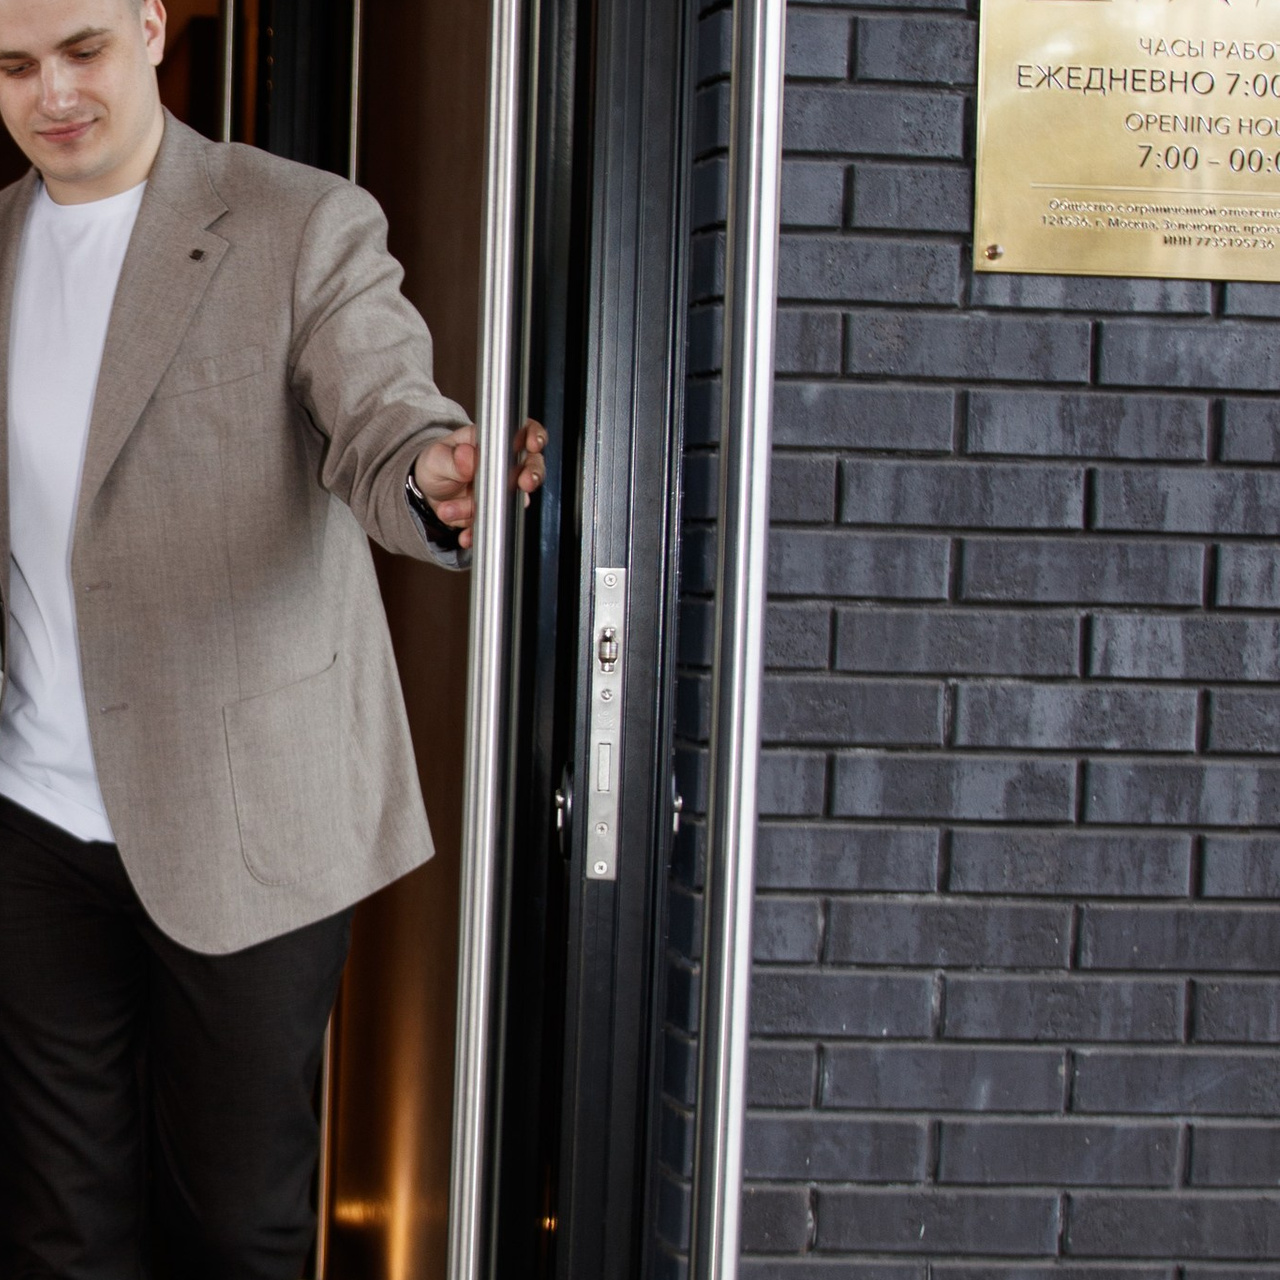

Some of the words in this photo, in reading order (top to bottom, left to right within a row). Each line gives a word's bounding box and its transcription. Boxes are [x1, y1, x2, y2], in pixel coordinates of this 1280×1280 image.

[1139, 37, 1205, 58] ЧАСЫ
[1017, 64, 1216, 96] ЕЖЕДНЕВНО
[1125, 113, 1231, 135] OPENING
[1138, 144, 1199, 171] 7:00
[1049, 198, 1114, 213] Общество
[1163, 234, 1191, 246] ИНН
